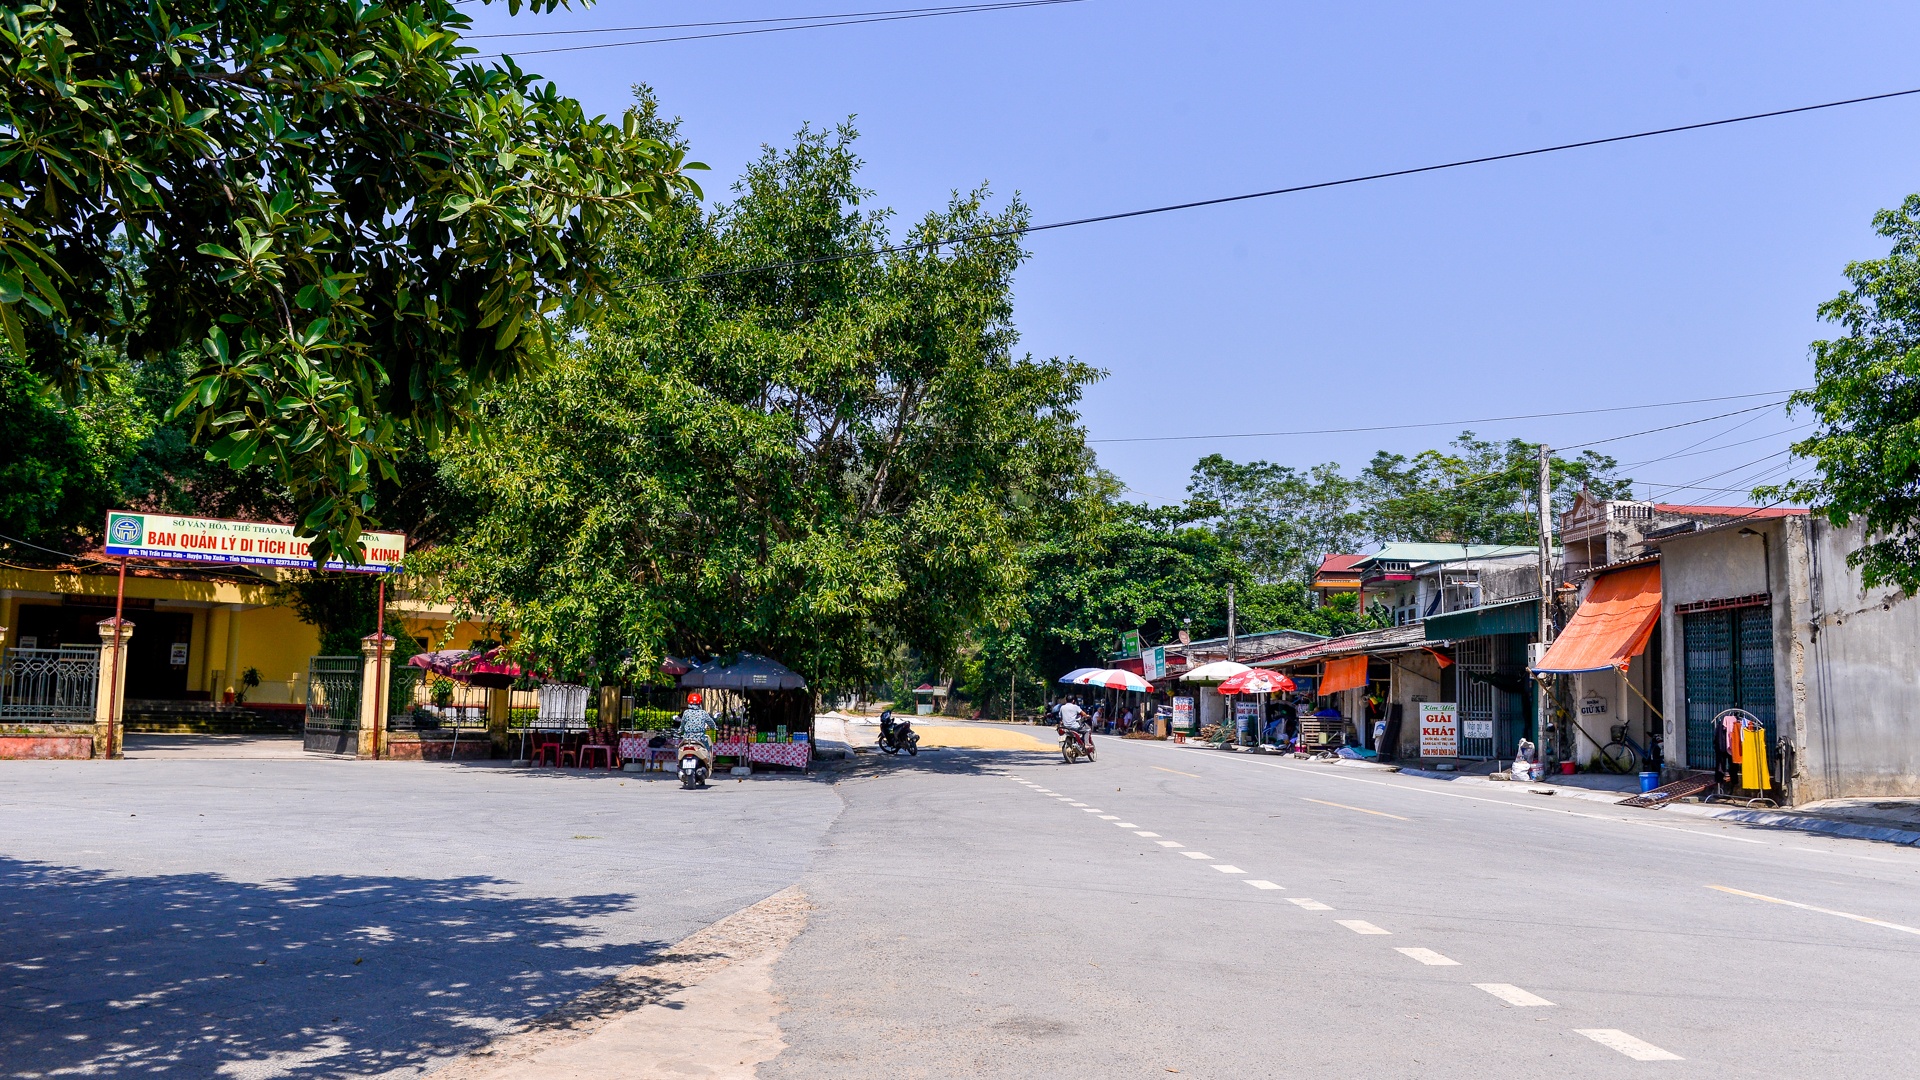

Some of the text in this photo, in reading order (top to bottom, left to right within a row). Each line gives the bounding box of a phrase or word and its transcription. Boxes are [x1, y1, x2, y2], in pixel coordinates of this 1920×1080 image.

[173, 518, 185, 526] SỞ
[252, 526, 278, 534] THAO
[280, 526, 291, 535] VÀ
[148, 531, 176, 546] BAN
[180, 530, 217, 549] QUẢN
[221, 534, 238, 550] LÝ
[240, 538, 253, 552] DI
[258, 538, 286, 554] TÍCH
[289, 542, 312, 558] LỊC
[371, 548, 399, 562] KINH
[1426, 712, 1452, 722] GIẢI
[1423, 726, 1455, 735] KHÁT
